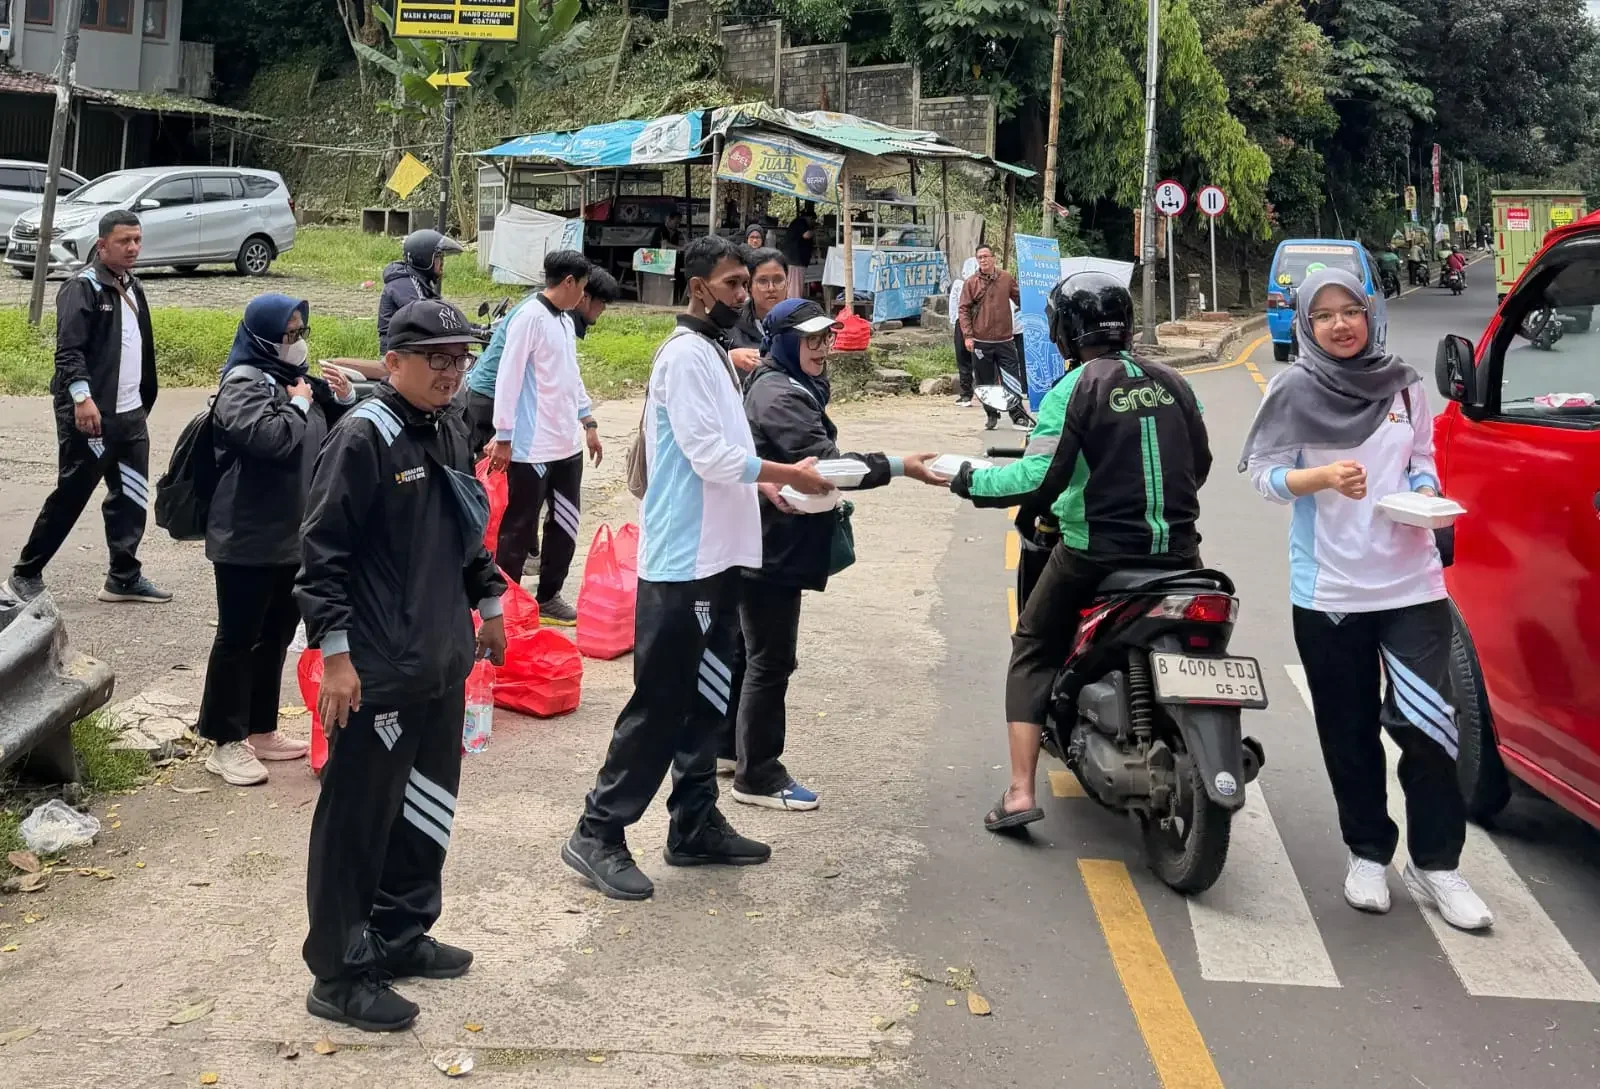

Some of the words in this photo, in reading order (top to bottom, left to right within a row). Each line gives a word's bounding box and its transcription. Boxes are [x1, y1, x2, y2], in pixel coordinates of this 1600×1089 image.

[482, 11, 511, 19] CERAMIC
[759, 156, 798, 173] JUARA
[806, 176, 826, 184] BERRY
[1109, 381, 1175, 413] Grab
[1159, 657, 1168, 674] B
[1178, 659, 1217, 677] 4096
[1223, 661, 1256, 679] EDJ
